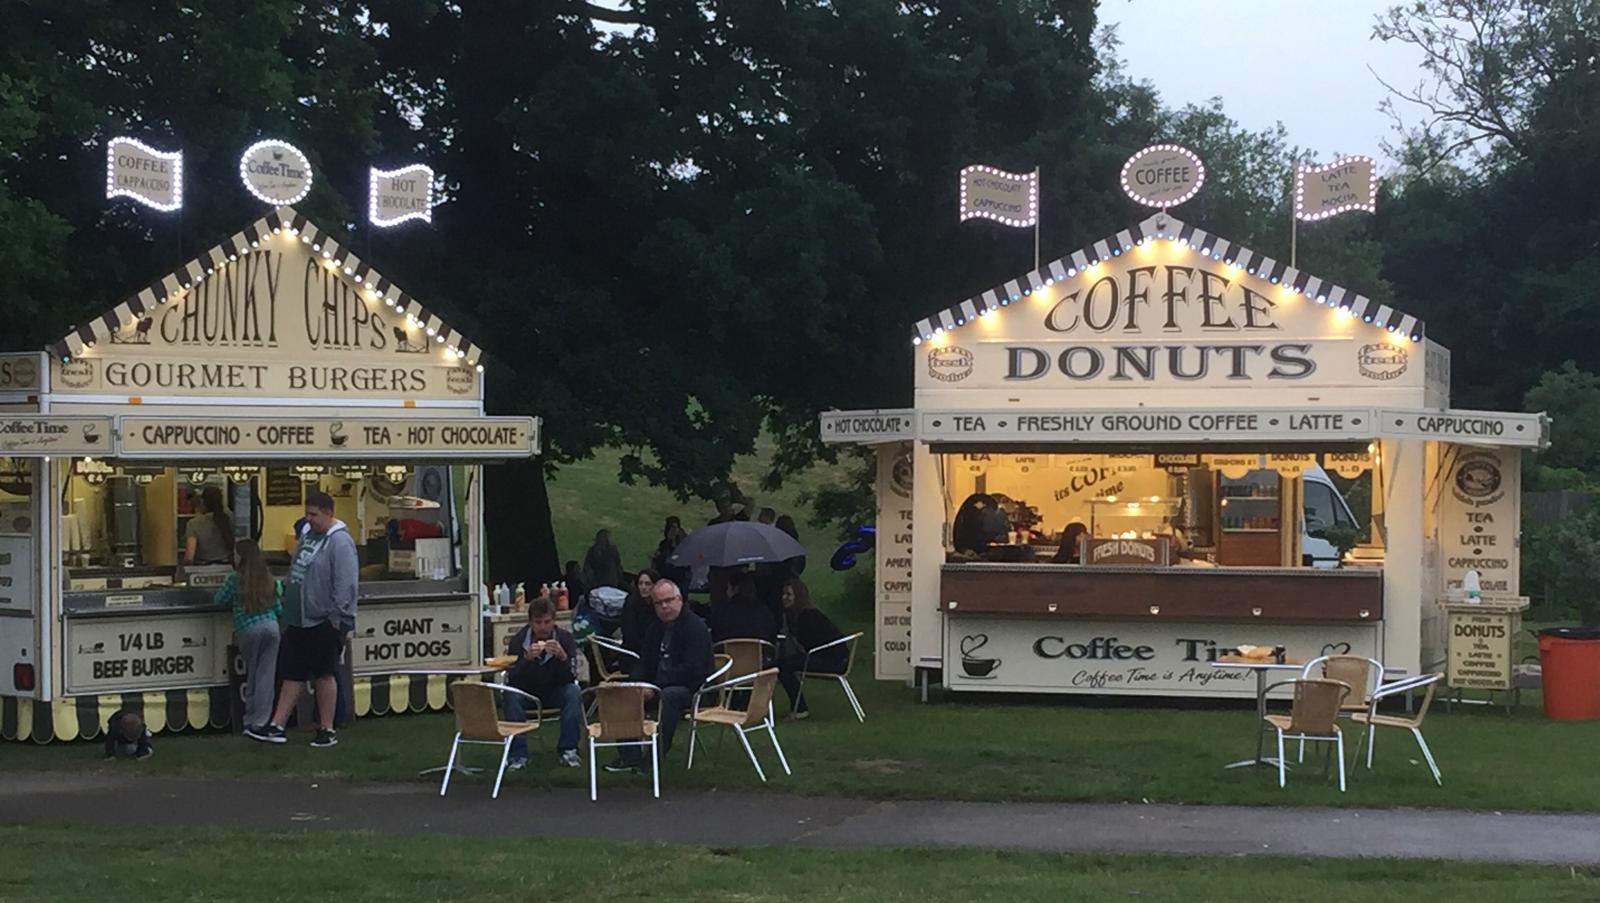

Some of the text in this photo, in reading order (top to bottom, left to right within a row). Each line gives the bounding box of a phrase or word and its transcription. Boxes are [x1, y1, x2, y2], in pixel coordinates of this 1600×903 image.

[118, 155, 168, 173] COFFEE
[1136, 167, 1190, 185] COFFEE
[1321, 166, 1357, 182] LATTE
[391, 178, 416, 192] HOT
[1328, 182, 1350, 192] TEA
[161, 250, 386, 350] CHUNKY CHIPS
[1044, 265, 1281, 333] COFFEE
[1003, 344, 1317, 380] DONUTS
[105, 362, 268, 389] GOURMET
[288, 366, 426, 392] BURGERS
[834, 418, 901, 433] HOT CHOCOLATE
[953, 415, 1344, 431] TEA FRESHLY GROUND COFFEE LATTE
[1417, 416, 1504, 435] CAPPUCCINO
[143, 425, 517, 446] CAPPUCCINO COFFEE TEA HOT CHOCOLATE
[962, 453, 992, 461] TEA
[898, 510, 912, 520] TE
[1466, 512, 1493, 523] TEA
[895, 533, 912, 544] LAT
[1461, 535, 1497, 546] LATTE
[1448, 558, 1509, 569] CAPPUCCINO
[884, 581, 912, 591] CAPPU
[383, 618, 434, 636] GIANT
[1454, 624, 1506, 638] DONUTS
[118, 633, 164, 651] 1/4 LB
[365, 640, 451, 661] HOT DOGS
[884, 642, 906, 652] COLD
[1032, 635, 1156, 660] Coffee
[93, 656, 194, 679] BEEF BURGER
[1071, 668, 1252, 688] Coffee Time is Anytime!
